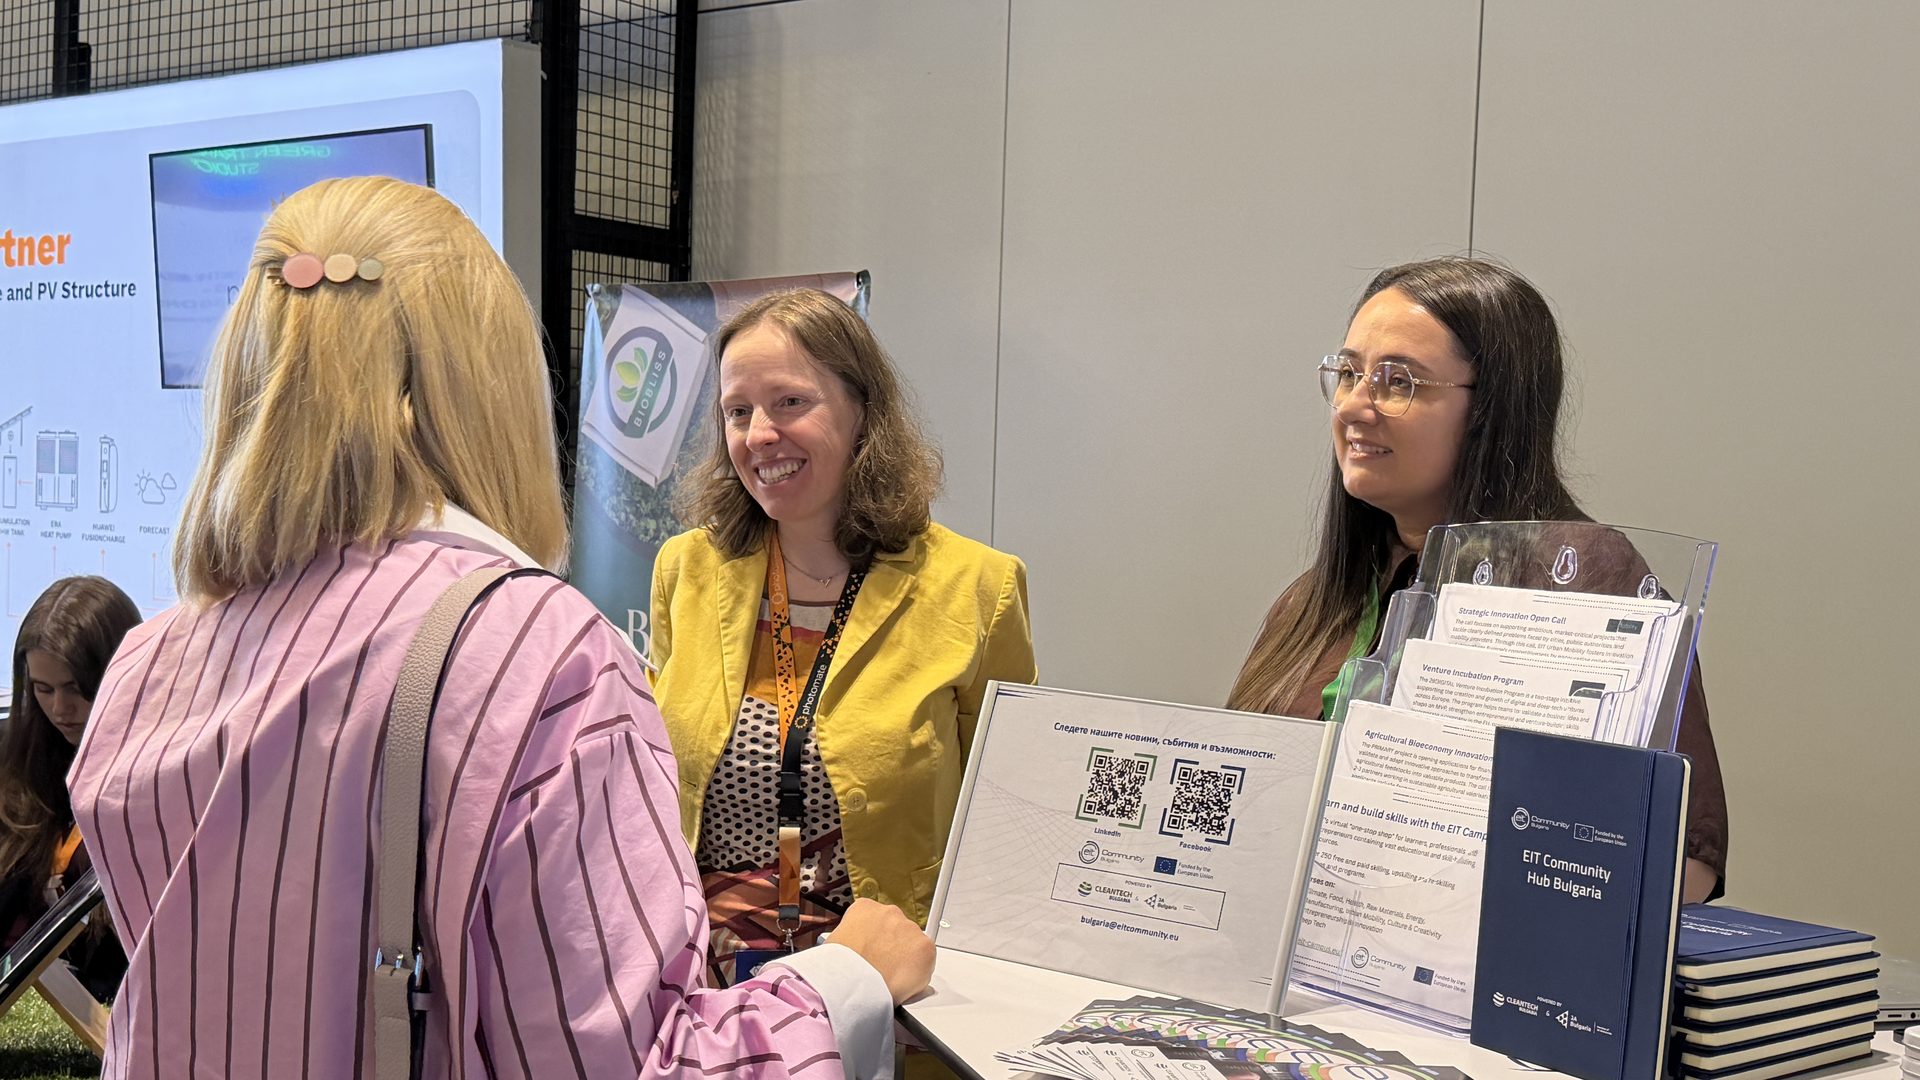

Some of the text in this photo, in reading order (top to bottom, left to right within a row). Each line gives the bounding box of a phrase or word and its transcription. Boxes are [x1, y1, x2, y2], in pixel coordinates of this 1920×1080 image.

[0, 229, 71, 268] tner
[7, 282, 33, 301] and
[38, 281, 57, 300] PV
[61, 280, 137, 299] Structure
[634, 350, 666, 427] BIOBLISS
[139, 525, 170, 535] FORECAST
[1458, 607, 1567, 625] Strategic Innovation Open Call
[1422, 664, 1524, 686] Venture Incubation Program
[802, 664, 827, 716] photomate
[1054, 722, 1089, 734] Следете
[1090, 728, 1123, 739] нашите
[1124, 733, 1160, 745] новини,
[1162, 738, 1199, 750] събития
[1209, 744, 1277, 760] възможности:
[1365, 730, 1494, 762] Agricultural Bioeconomy Innovation
[1341, 802, 1359, 813] and
[1360, 806, 1384, 819] build
[1385, 812, 1409, 825] skills
[1410, 817, 1429, 829] with
[1431, 821, 1445, 832] the
[1447, 824, 1462, 835] EIT
[1531, 815, 1570, 830] Community
[1094, 827, 1121, 838] LinkedIn
[1101, 849, 1145, 863] Community
[1178, 841, 1212, 853] Facebook
[1320, 851, 1332, 860] 250
[1333, 854, 1345, 863] free
[1522, 849, 1611, 884] EIT Community
[1095, 885, 1133, 898] CLEANTECH
[1324, 880, 1336, 889] on:
[1527, 871, 1602, 900] Hub Bulgaria
[1080, 915, 1179, 941] bulgaria@eitcommunity.eu
[1370, 955, 1407, 971] Community
[1506, 996, 1539, 1011] CLEANTECH
